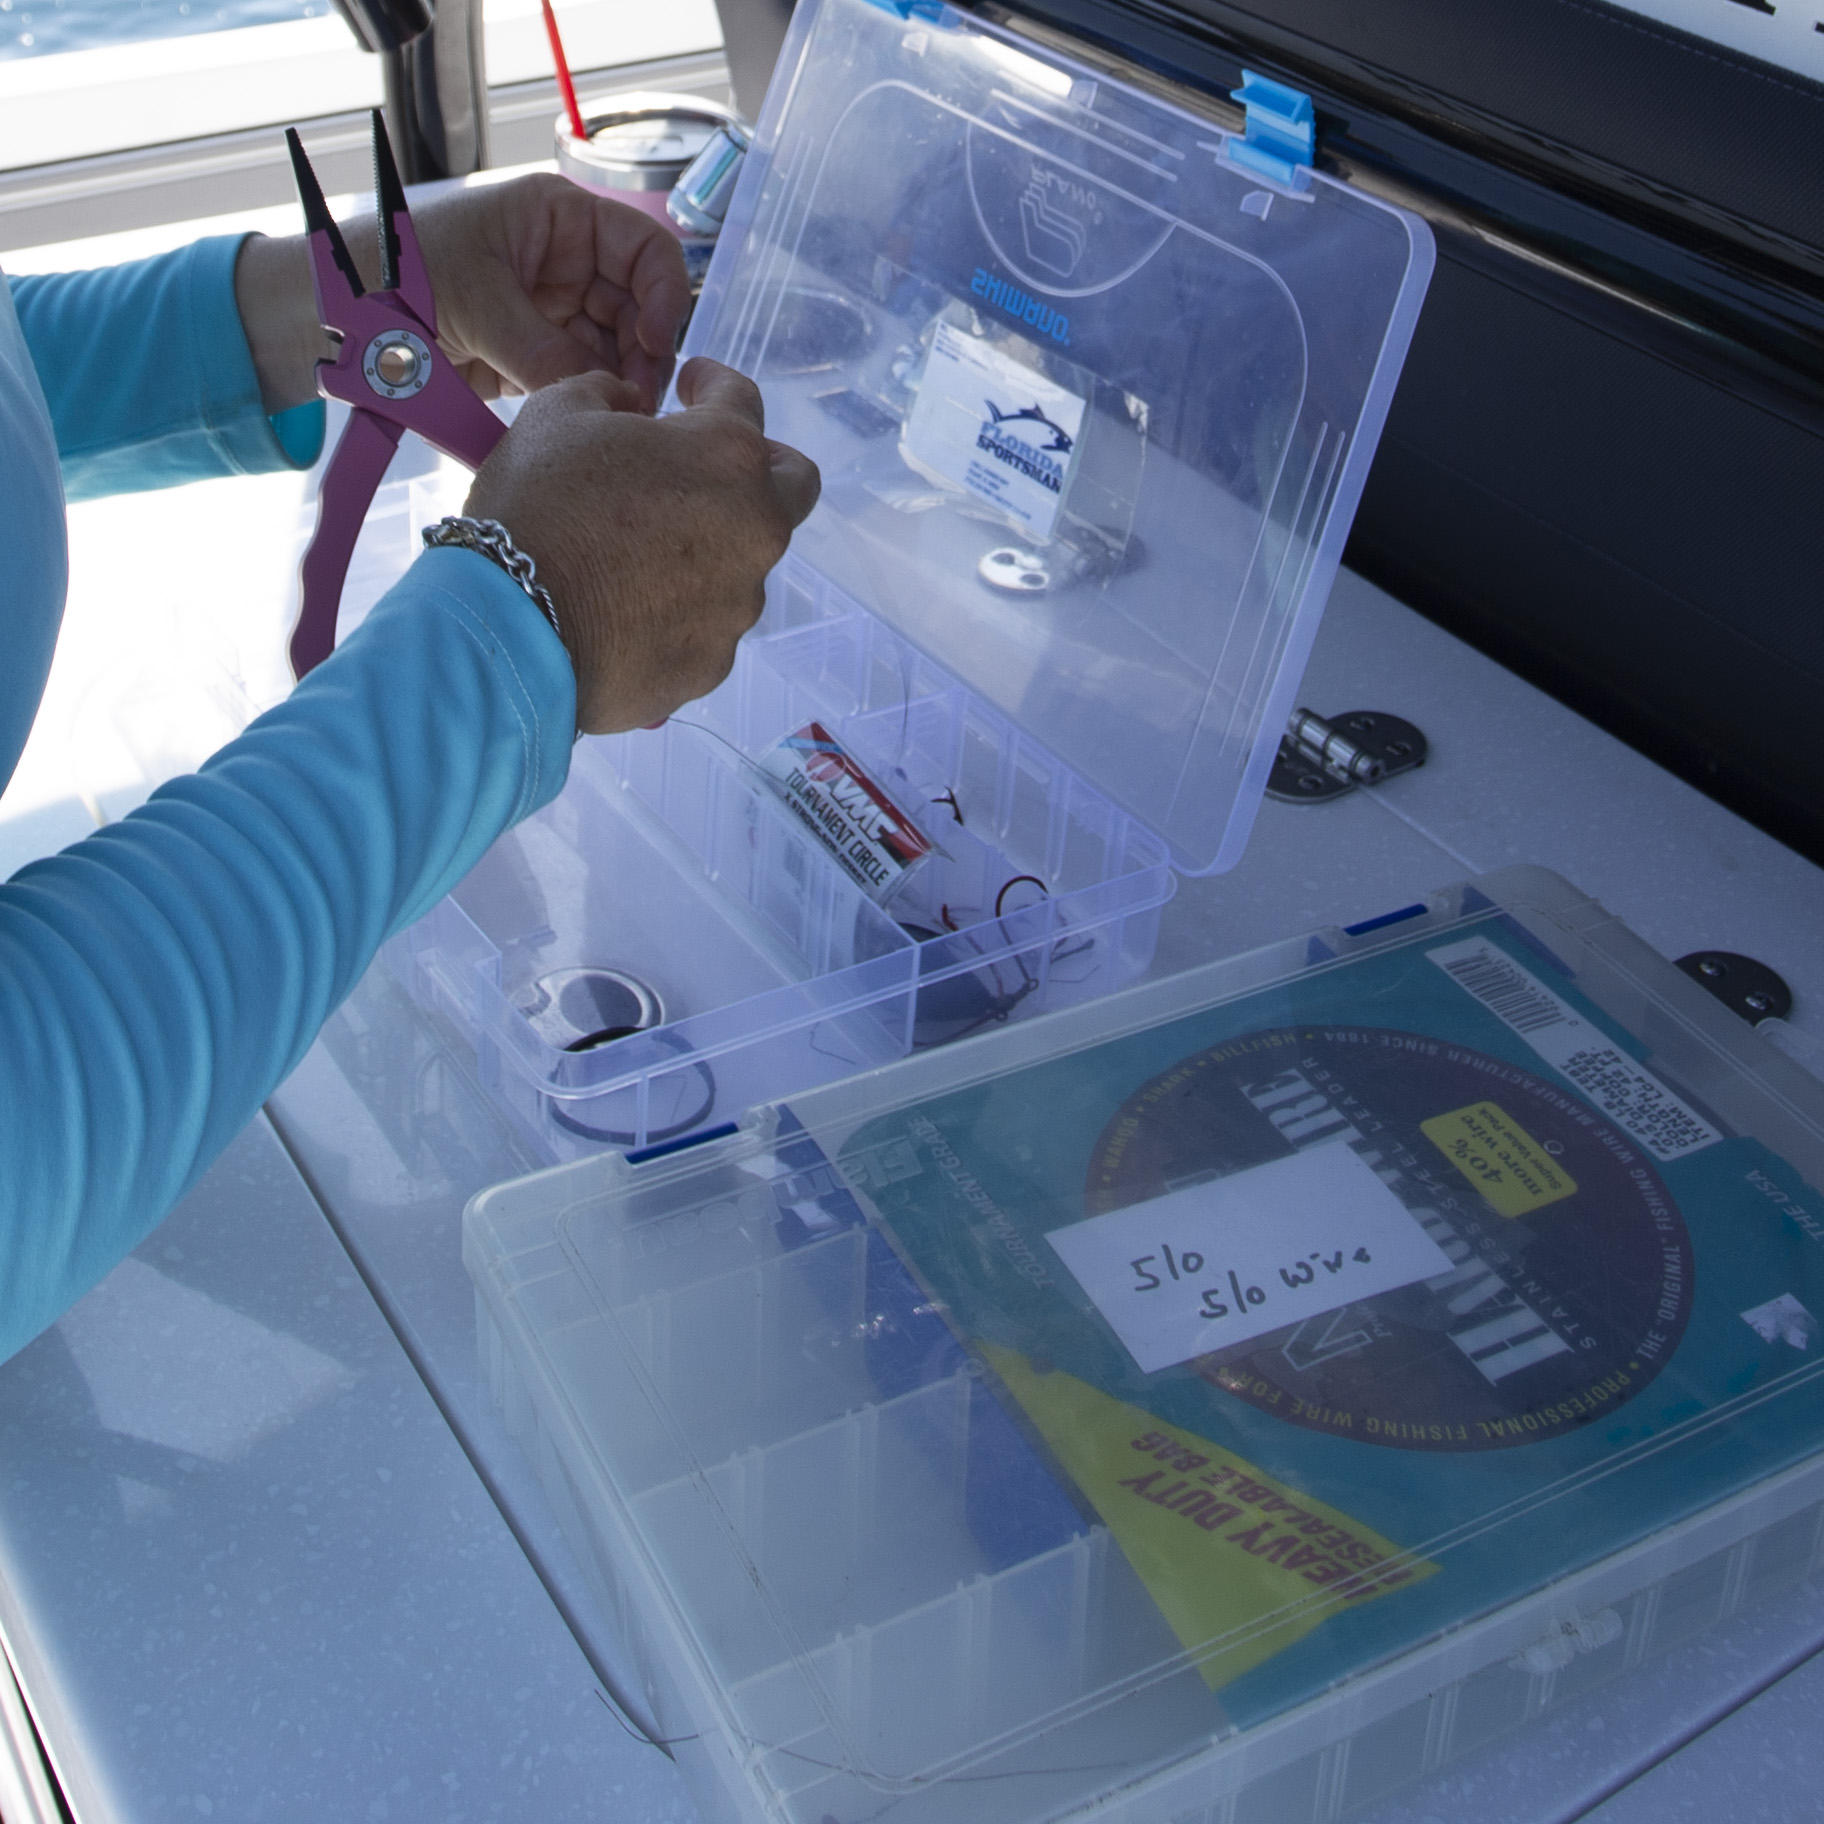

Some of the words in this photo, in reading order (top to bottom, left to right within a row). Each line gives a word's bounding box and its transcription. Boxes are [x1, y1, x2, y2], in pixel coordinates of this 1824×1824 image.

[976, 434, 1062, 494] SPORTSMAN
[980, 421, 1064, 479] FLORIDA
[785, 767, 855, 847] TOURNAMENT
[847, 838, 889, 887] CIRCLE
[1324, 1031, 1370, 1044] 1884
[1379, 1037, 1440, 1057] SINCE
[1142, 1067, 1195, 1103] SHARK
[1212, 1034, 1296, 1063] BILLFISH
[1448, 1049, 1595, 1126] MANUFACTURER
[1560, 1063, 1595, 1093] TEST
[1568, 1057, 1643, 1121] DIAMETER
[1576, 1051, 1631, 1097] COFFEE
[1302, 1056, 1383, 1132] LEADER
[1636, 1087, 1699, 1143] LENGTH:
[908, 1116, 963, 1169] GRADE
[1461, 1115, 1498, 1149] wire
[1479, 1108, 1505, 1131] Pack
[1626, 1119, 1647, 1135] 40
[1633, 1099, 1689, 1148] COLOR:
[1665, 1101, 1710, 1140] ITEM:
[1448, 1139, 1503, 1183] 40%
[1502, 1131, 1531, 1159] Value
[1596, 1127, 1634, 1165] WIRE
[1390, 1141, 1456, 1209] STEEL
[1498, 1150, 1543, 1196] more
[1530, 1157, 1562, 1190] Super
[1745, 1169, 1789, 1204] USA
[1630, 1169, 1674, 1231] FISHING
[949, 1172, 1054, 1290] TOURNAMENT
[1465, 1220, 1596, 1350] STAINLESS
[1637, 1329, 1667, 1359] THE
[1234, 1371, 1282, 1404] FOR
[1476, 1368, 1632, 1439] PROFESSIONAL
[1289, 1396, 1354, 1428] WIRE
[1365, 1417, 1468, 1441] FISHING
[1131, 1431, 1211, 1473] BAG
[1117, 1470, 1244, 1532] DUTY
[1199, 1465, 1416, 1585] RESEALABLE
[1226, 1521, 1378, 1600] HEAVY
